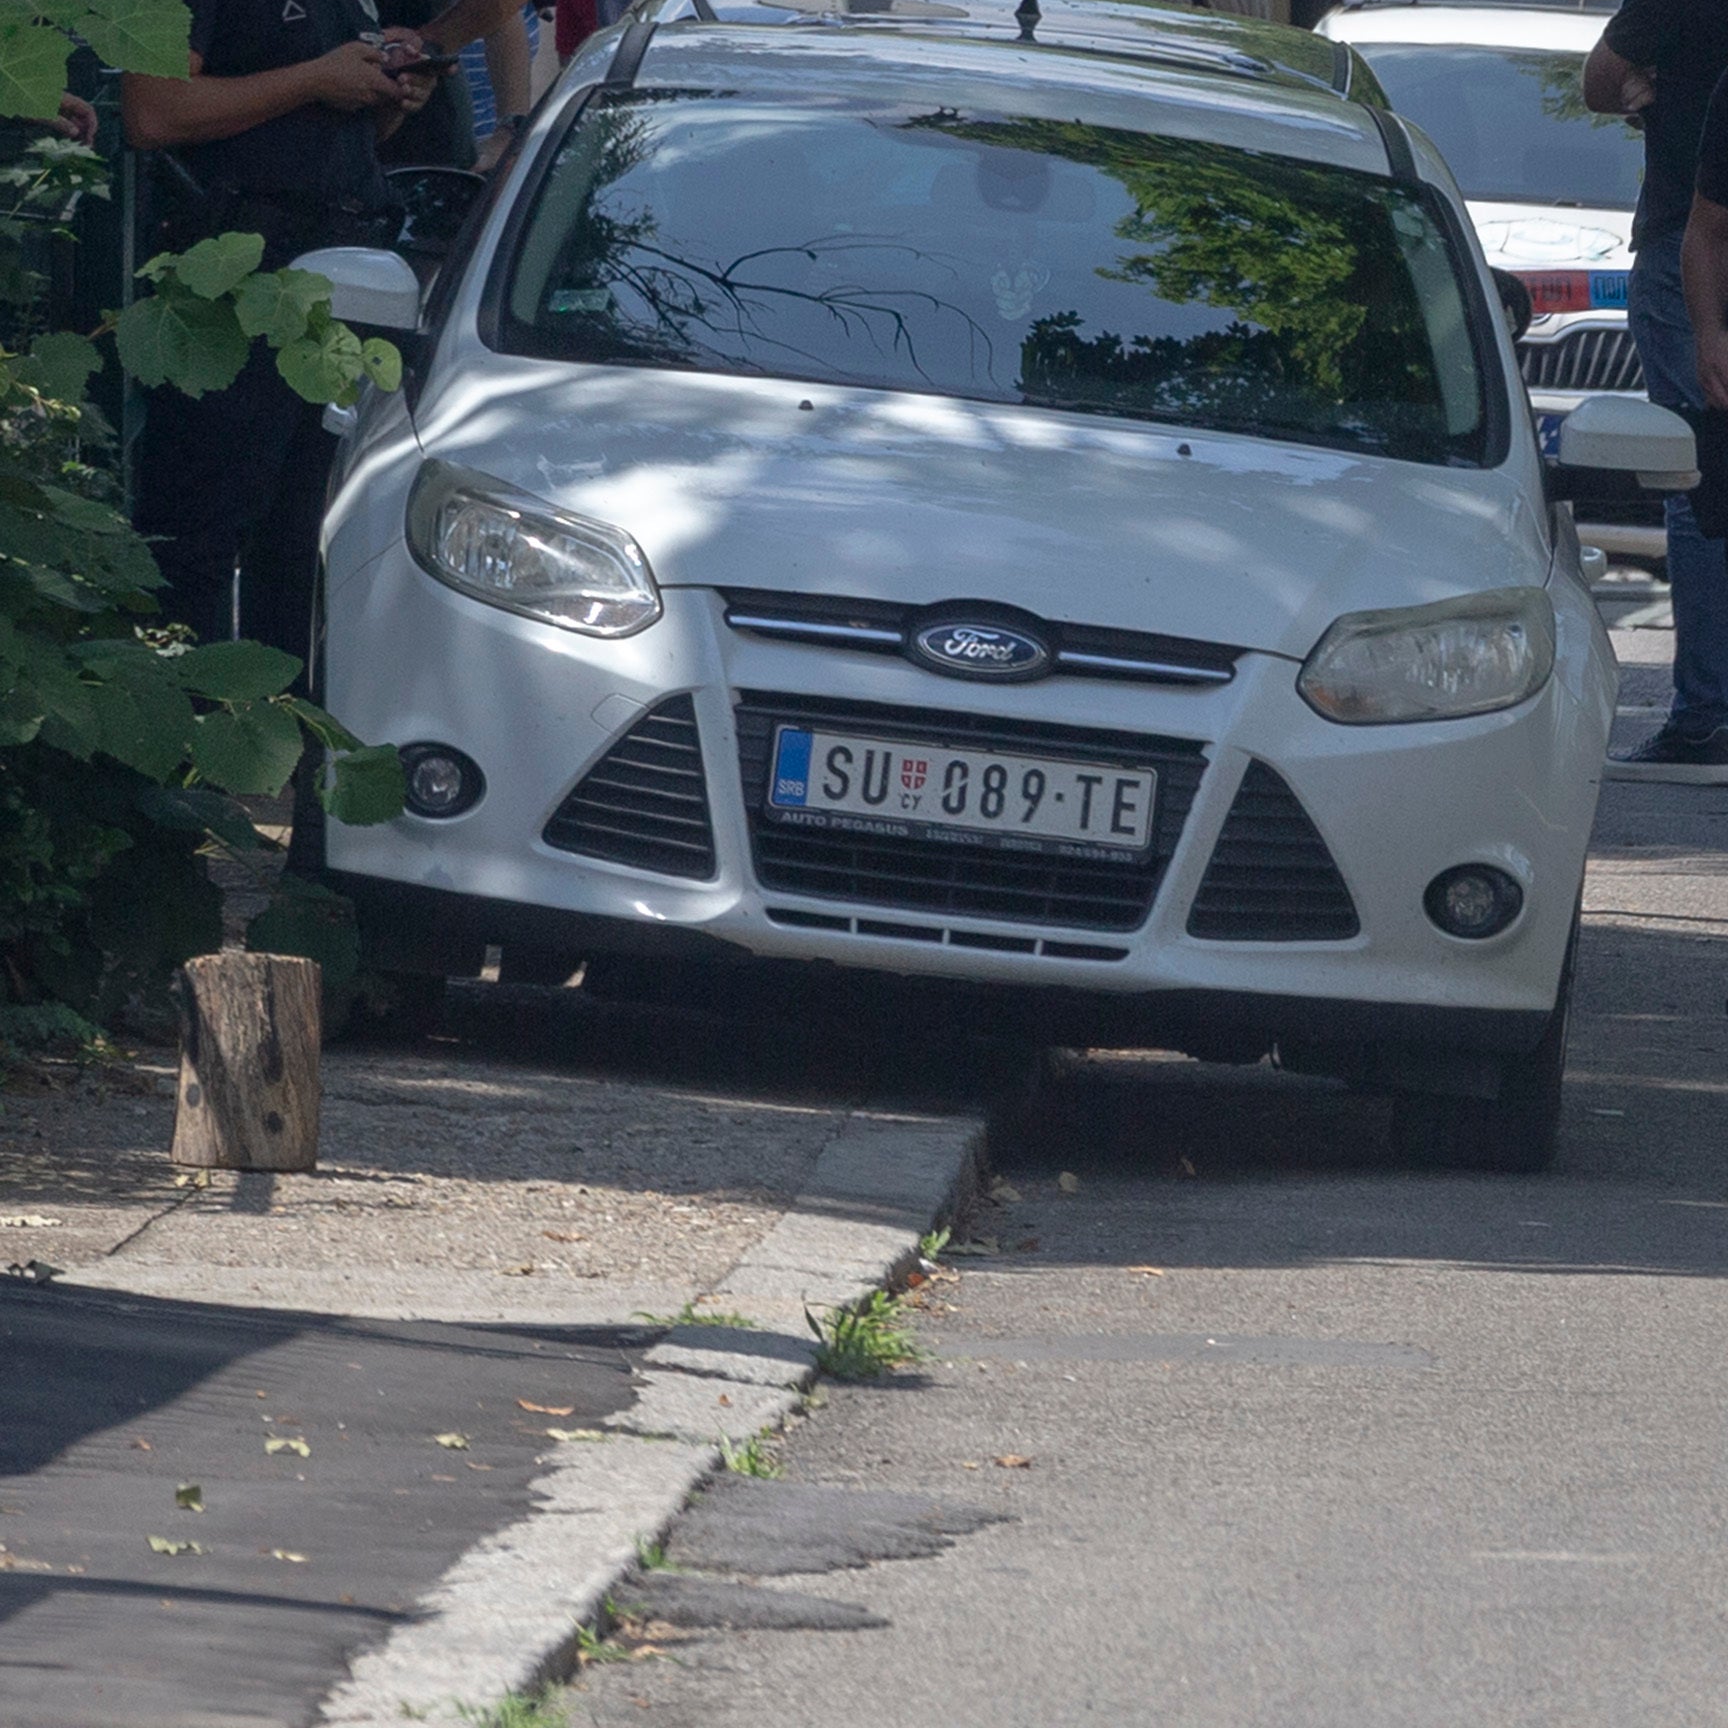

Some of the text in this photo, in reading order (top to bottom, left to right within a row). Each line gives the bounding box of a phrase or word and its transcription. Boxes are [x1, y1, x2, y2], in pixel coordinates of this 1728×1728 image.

[944, 628, 1016, 660] Ford
[778, 778, 805, 797] SRB
[822, 745, 892, 806] SU
[781, 812, 827, 828] AUTO
[831, 818, 909, 837] PEGASUS
